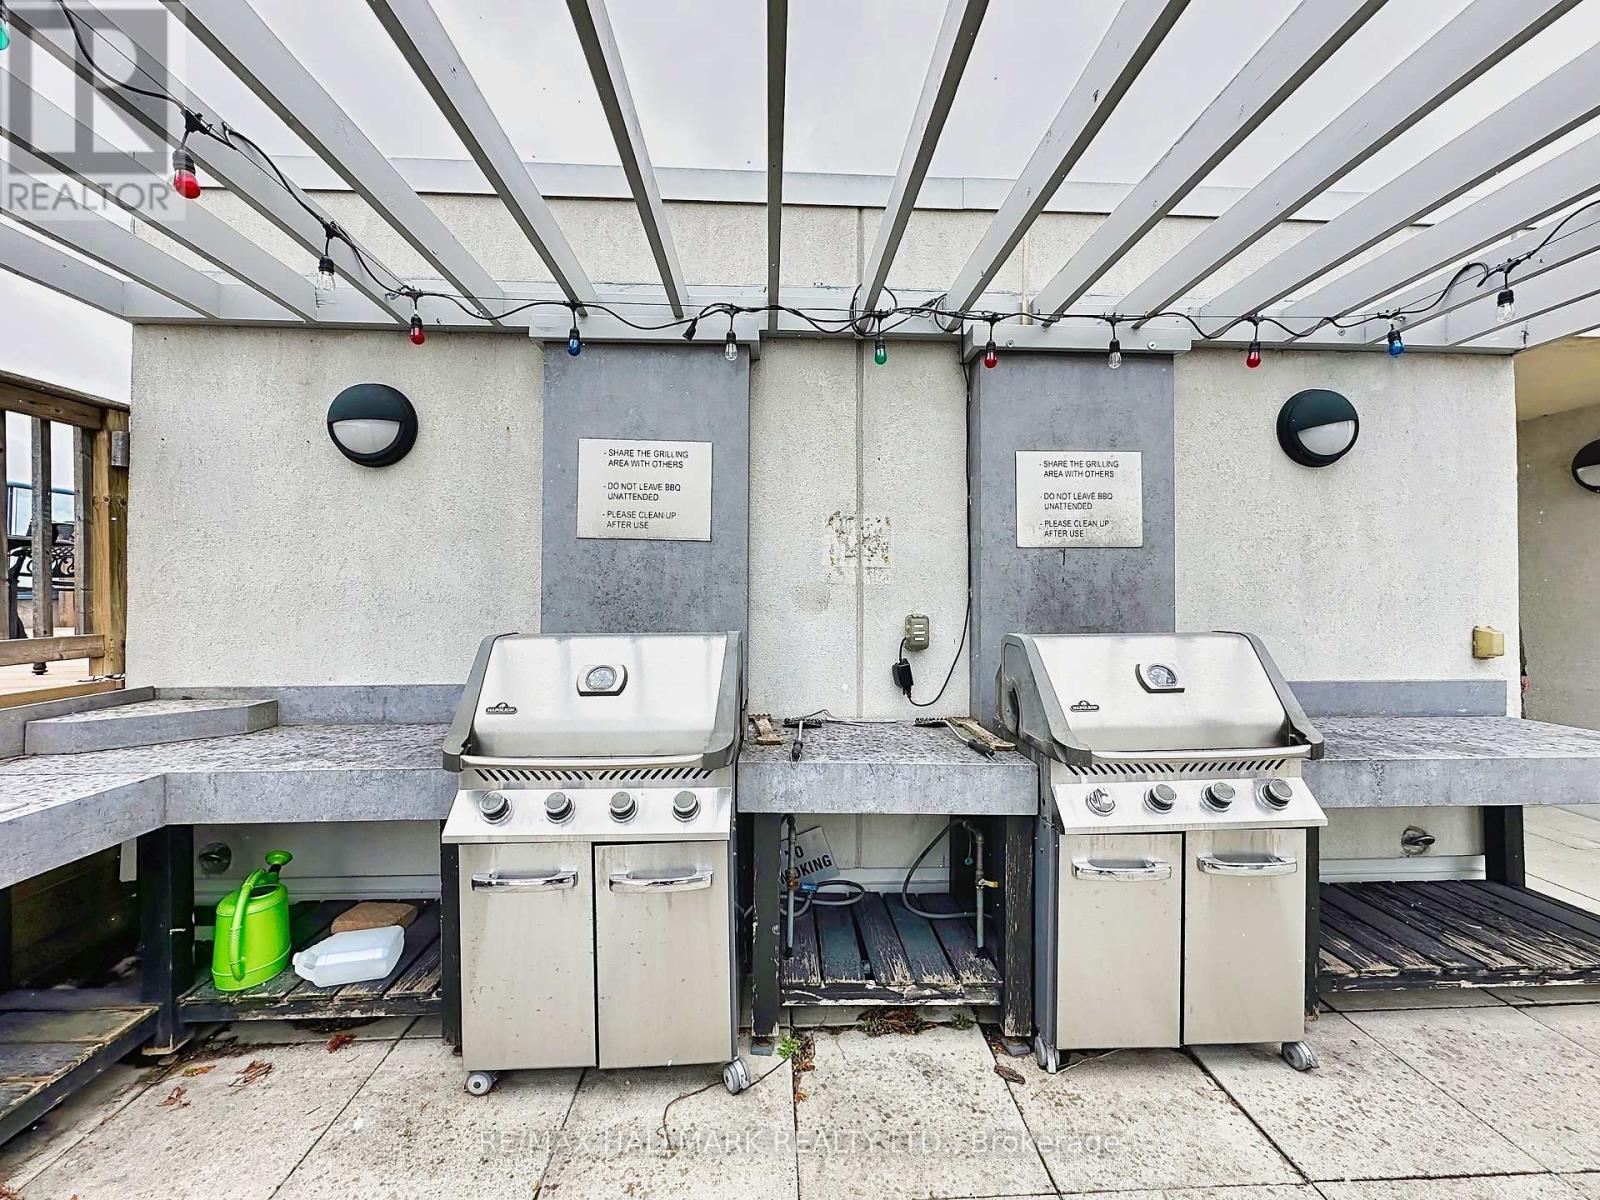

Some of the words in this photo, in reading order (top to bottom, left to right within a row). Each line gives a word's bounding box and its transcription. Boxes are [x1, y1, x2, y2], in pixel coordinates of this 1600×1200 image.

[608, 449, 635, 458] SHARE
[637, 449, 652, 458] THE
[653, 450, 689, 459] GRILLING
[608, 459, 630, 467] AREA
[631, 460, 650, 468] WITH
[652, 460, 684, 469] OTHERS
[1043, 460, 1068, 468] SHARE
[1070, 460, 1084, 468] THE
[1085, 460, 1119, 468] GRILLING
[1043, 470, 1064, 478] AREA
[1065, 470, 1084, 478] WITH
[1084, 470, 1115, 478] OTHERS
[607, 482, 619, 490] DO
[621, 482, 638, 490] NOT
[639, 483, 663, 491] LEAVE
[664, 483, 681, 492] BBQ
[607, 492, 659, 501] UNATTENDED
[1043, 492, 1055, 500] DO
[1056, 492, 1072, 500] NOT
[1073, 492, 1096, 500] LEAVE
[1097, 492, 1113, 500] BBQ
[1044, 502, 1093, 510] UNATTENDED
[606, 510, 637, 519] PLEASE
[638, 511, 664, 519] CLEAN
[665, 511, 677, 519] UP
[633, 521, 649, 529] USE
[1044, 520, 1072, 528] PLEASE
[1073, 520, 1098, 528] CLEAN
[1099, 520, 1110, 528] UP
